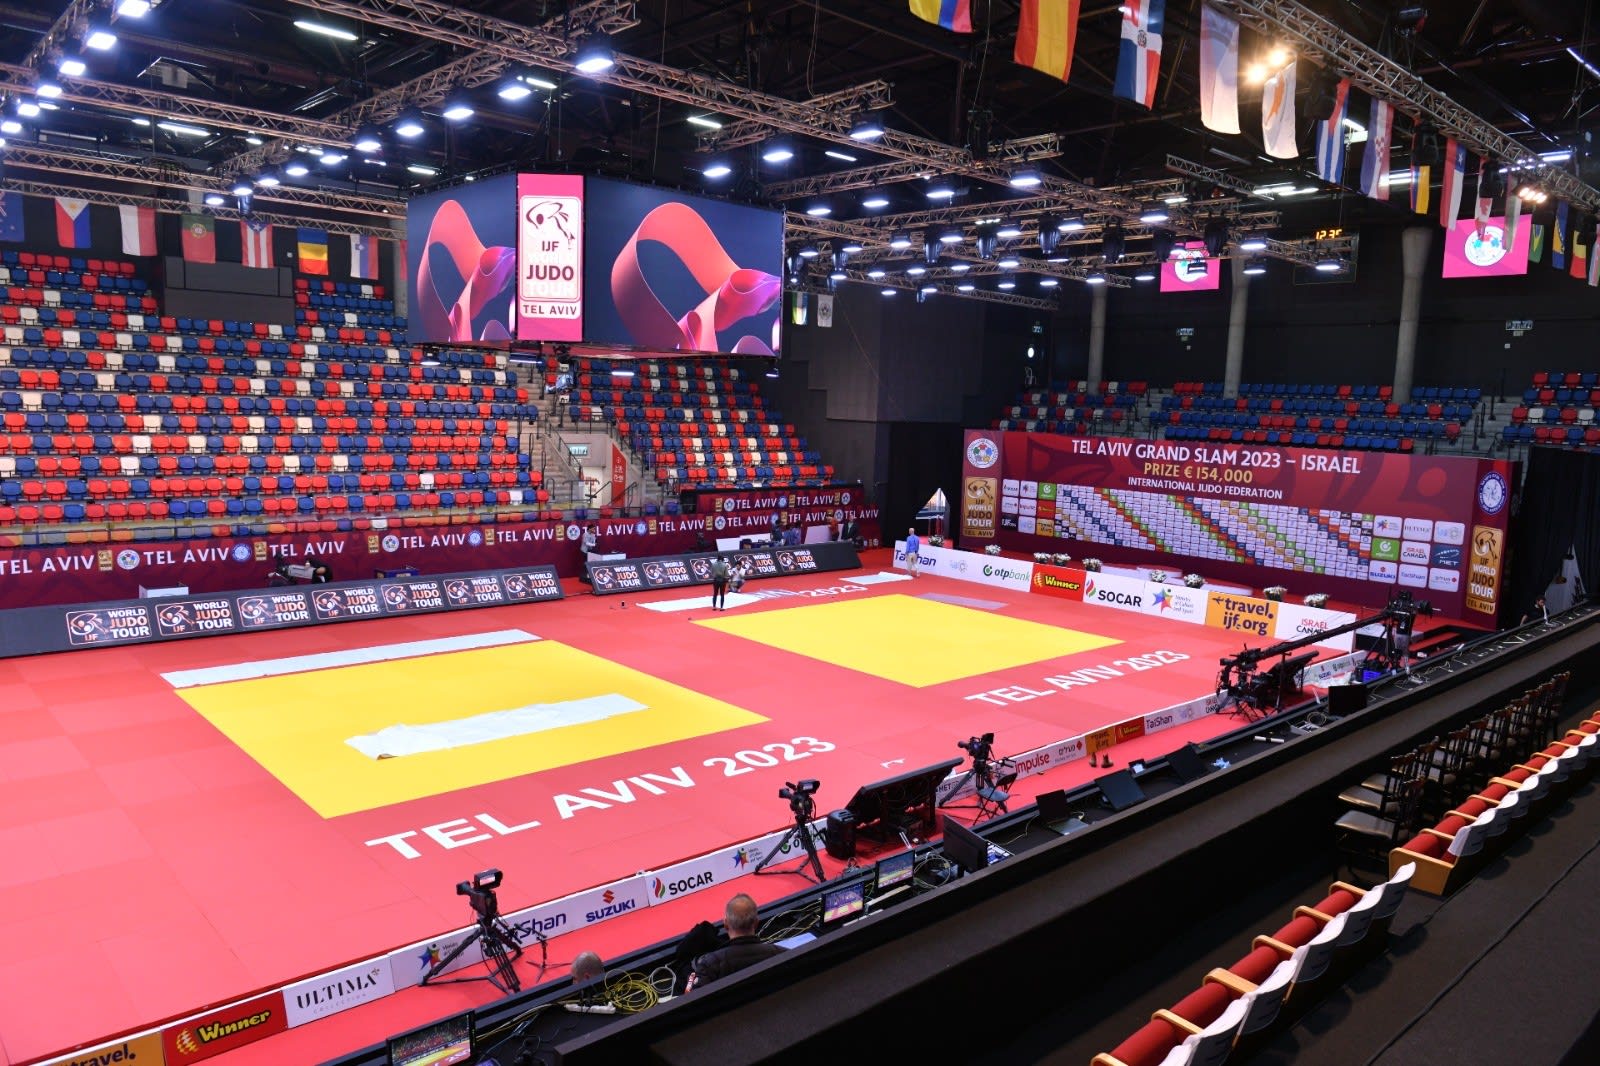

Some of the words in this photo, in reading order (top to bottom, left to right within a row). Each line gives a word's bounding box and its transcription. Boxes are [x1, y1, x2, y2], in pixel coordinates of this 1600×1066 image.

[542, 240, 560, 252] IJF
[526, 264, 574, 281] JUDO
[523, 304, 544, 314] TEL
[549, 306, 577, 316] AVIV
[1072, 440, 1093, 454] TEL
[1096, 441, 1132, 457] AVIV
[1136, 444, 1190, 461] GRAND
[1194, 448, 1237, 466] SLAM
[1240, 450, 1281, 468] 2023
[1301, 454, 1361, 474] ISRAEL
[1144, 462, 1180, 478] PRIZE
[1128, 476, 1196, 492] INTERNATIONAL
[1197, 484, 1222, 494] JUDO
[1224, 486, 1283, 500] FEDERATION
[736, 500, 750, 509] TEL
[754, 498, 777, 508] AVIV
[796, 496, 810, 506] TEL
[813, 494, 834, 505] AVIV
[860, 509, 879, 519] AVIV
[968, 504, 993, 512] WORLD
[726, 517, 742, 527] TEL
[746, 514, 769, 526] AVIV
[805, 512, 826, 523] AVIV
[968, 510, 993, 519] JUDO
[658, 522, 676, 532] TEL
[680, 520, 704, 530] AVIV
[966, 519, 993, 528] TOUR
[496, 530, 518, 543] TEL
[522, 528, 554, 541] AVIV
[606, 524, 634, 536] AVIV
[401, 536, 425, 549] TEL
[430, 534, 466, 548] AVIV
[269, 543, 298, 558] TEL
[304, 540, 345, 556] AVIV
[143, 550, 175, 566] TEL
[183, 547, 229, 563] AVIV
[797, 555, 814, 564] JUDO
[894, 550, 937, 566] Tahan
[1402, 552, 1427, 560] CANADA
[42, 554, 94, 573] AVIV
[614, 565, 636, 573] WORLD
[756, 559, 774, 567] JUDO
[528, 572, 553, 580] WORLD
[616, 572, 638, 580] JUDO
[666, 566, 687, 576] JUDO
[994, 564, 1030, 582] otpbank
[1370, 571, 1396, 579] SUZUKI
[1472, 564, 1496, 576] WORLD
[471, 577, 497, 586] WORLD
[530, 579, 555, 588] JUDO
[618, 578, 641, 587] TOUR
[667, 574, 690, 582] TOUR
[1044, 575, 1080, 591] Winner
[1471, 572, 1495, 588] JUDO
[344, 588, 374, 597] WORLD
[409, 582, 437, 591] WORLD
[473, 584, 500, 594] JUDO
[532, 586, 558, 596] TOUR
[1470, 584, 1494, 599] TOUR
[272, 594, 304, 604] WORLD
[346, 595, 376, 606] JUDO
[412, 590, 439, 600] JUDO
[474, 592, 502, 602] TOUR
[1098, 589, 1142, 608] SOCAR
[193, 601, 229, 610] WORLD
[273, 602, 306, 614] JUDO
[348, 603, 379, 615] TOUR
[414, 598, 443, 608] TOUR
[1480, 601, 1494, 612] AVIV
[108, 608, 146, 618] WORLD
[194, 608, 230, 620] JUDO
[275, 610, 309, 623] TOUR
[109, 616, 148, 629] JUDO
[196, 618, 233, 630] TOUR
[1301, 618, 1328, 630] ISRAEL
[112, 626, 150, 639] TOUR
[964, 685, 1056, 706] TEL
[1043, 664, 1124, 690] AVIV
[1112, 650, 1192, 671] 2023
[1146, 715, 1173, 730] TaiShan
[1016, 754, 1050, 774] impulse
[364, 812, 542, 860] TEL
[552, 765, 696, 820] AVIV
[702, 735, 837, 778] 2023
[668, 871, 714, 896] SOCAR
[585, 898, 636, 924] SUZUKI
[296, 973, 378, 1009] ULTIMA
[198, 1010, 271, 1044] Winner
